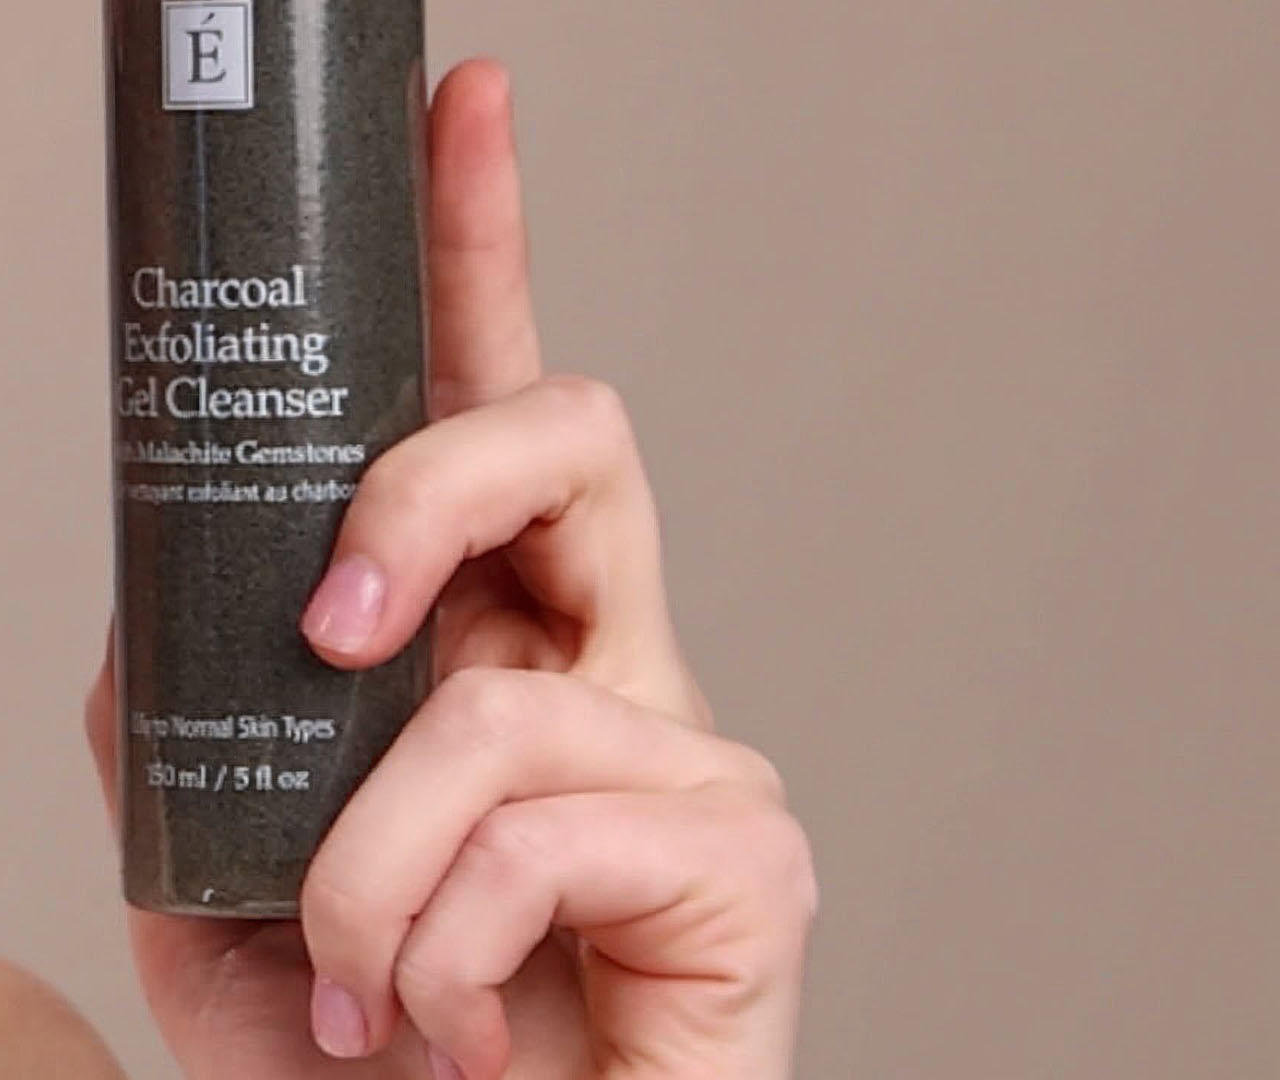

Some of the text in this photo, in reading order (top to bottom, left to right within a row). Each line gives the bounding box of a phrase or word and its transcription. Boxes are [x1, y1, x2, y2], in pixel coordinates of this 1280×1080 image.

[186, 12, 227, 85] É
[132, 264, 309, 309] Charcoal
[124, 321, 330, 376] Exfoliating
[118, 375, 349, 419] Gel Cleanser
[137, 440, 232, 464] Malachite
[235, 439, 366, 464] Gemstones
[264, 485, 289, 502] au
[292, 479, 356, 502] charbo
[171, 715, 234, 740] Normal
[239, 714, 279, 739] Skin
[283, 715, 336, 744] Types
[178, 764, 206, 789] ml
[214, 764, 228, 792] /
[234, 766, 250, 790] 5
[255, 764, 273, 790] fl
[277, 769, 310, 790] oz
